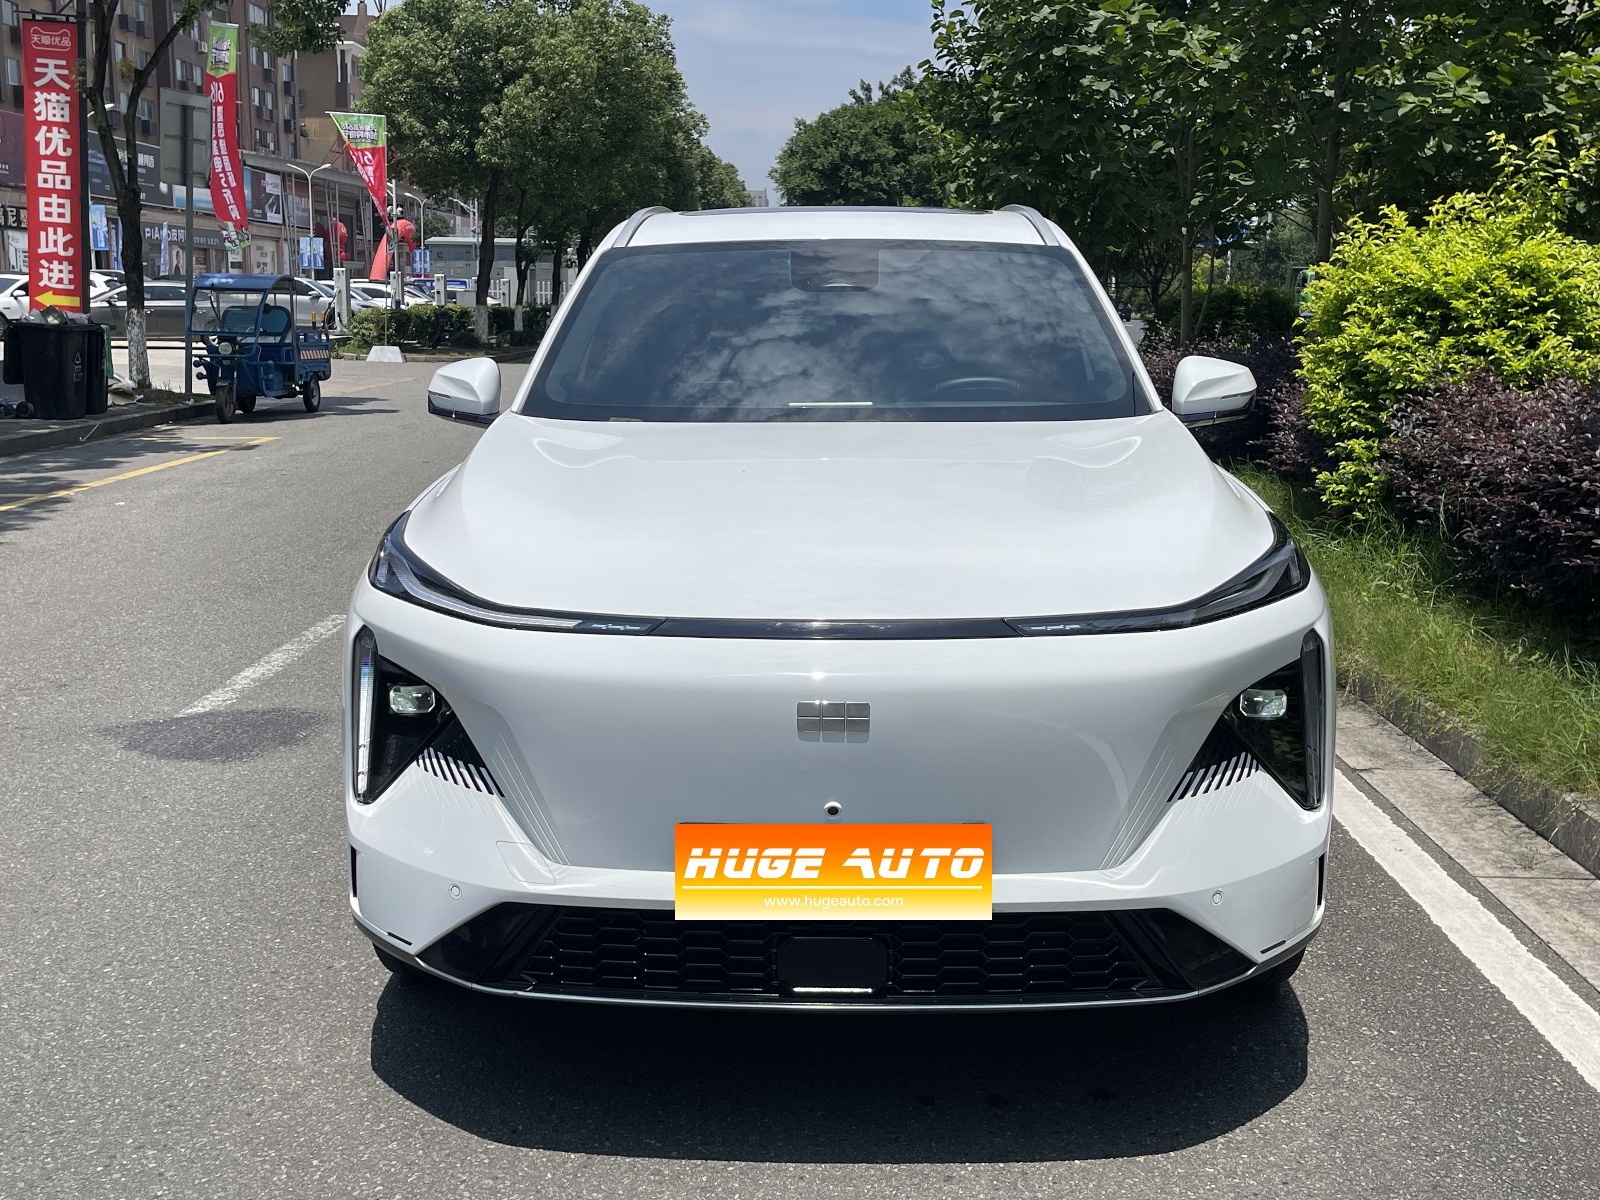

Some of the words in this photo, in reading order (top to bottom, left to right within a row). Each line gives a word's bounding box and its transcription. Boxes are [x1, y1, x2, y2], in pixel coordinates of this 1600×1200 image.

[30, 36, 71, 47] 天猫优品
[33, 57, 75, 291] 天猫优品由此进
